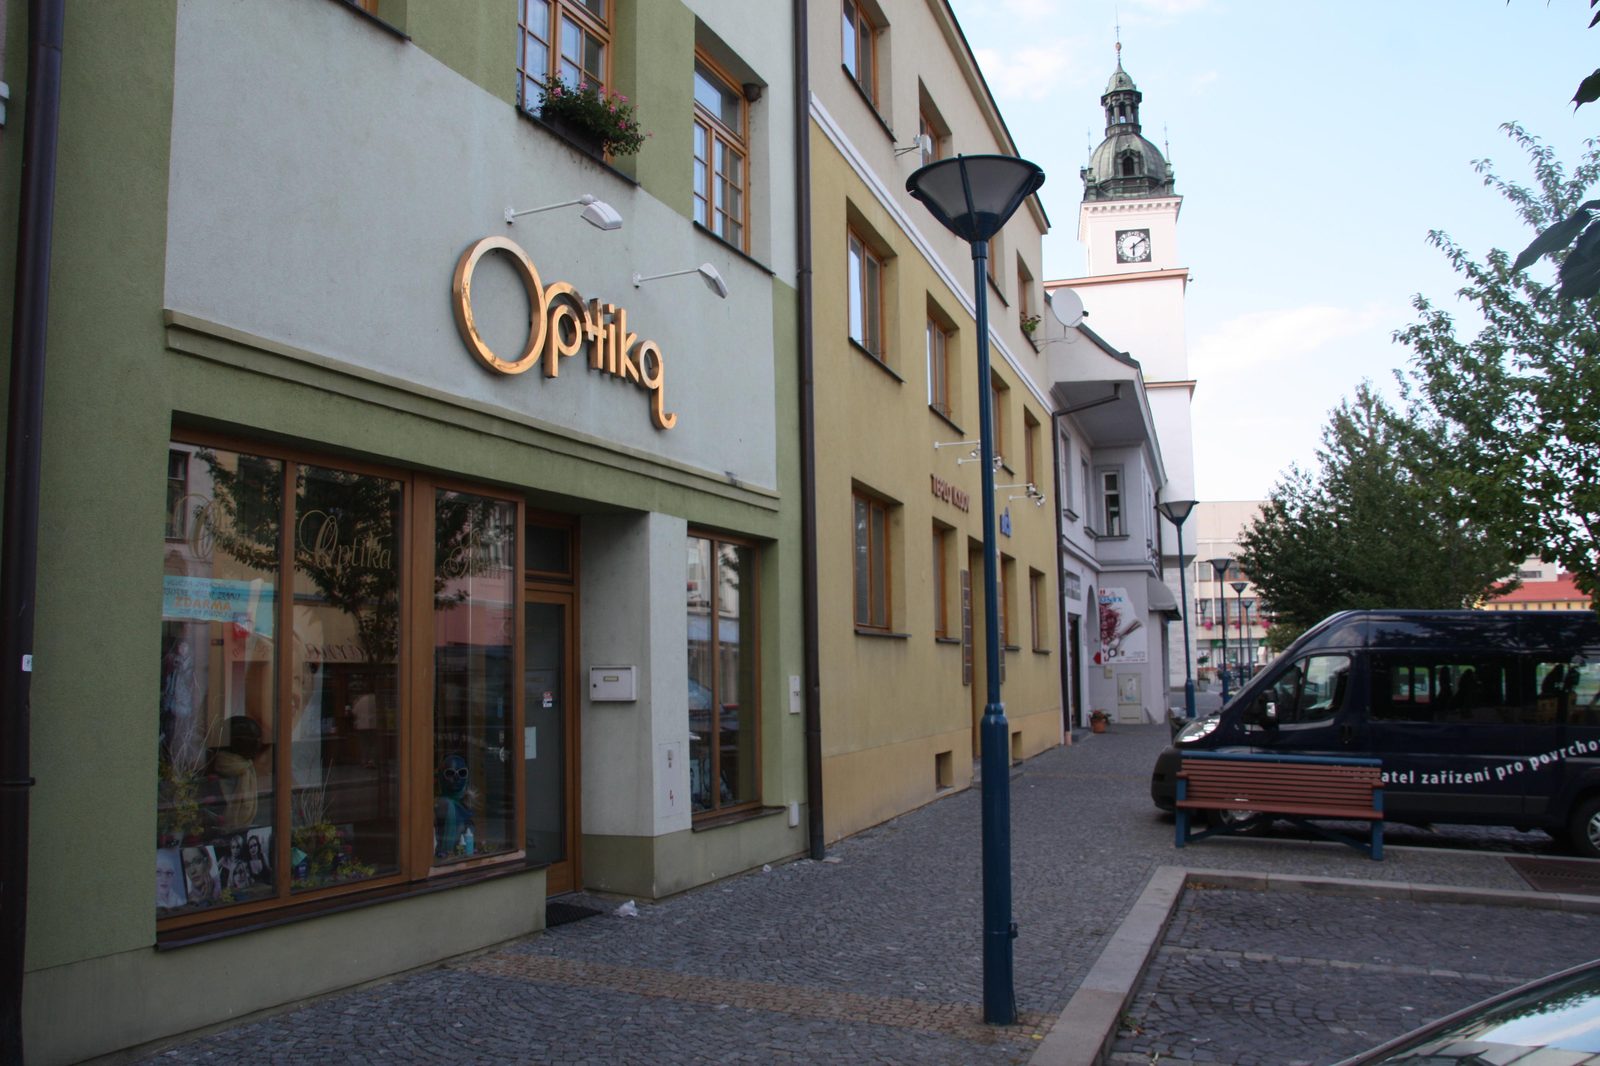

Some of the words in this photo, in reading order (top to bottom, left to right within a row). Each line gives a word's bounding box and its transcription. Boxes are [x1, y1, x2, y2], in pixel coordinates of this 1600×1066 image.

[452, 236, 678, 430] Optika
[299, 509, 392, 577] Optika
[1421, 767, 1491, 784] zařízení
[1495, 759, 1524, 781] pro
[1529, 739, 1600, 771] povrcho
